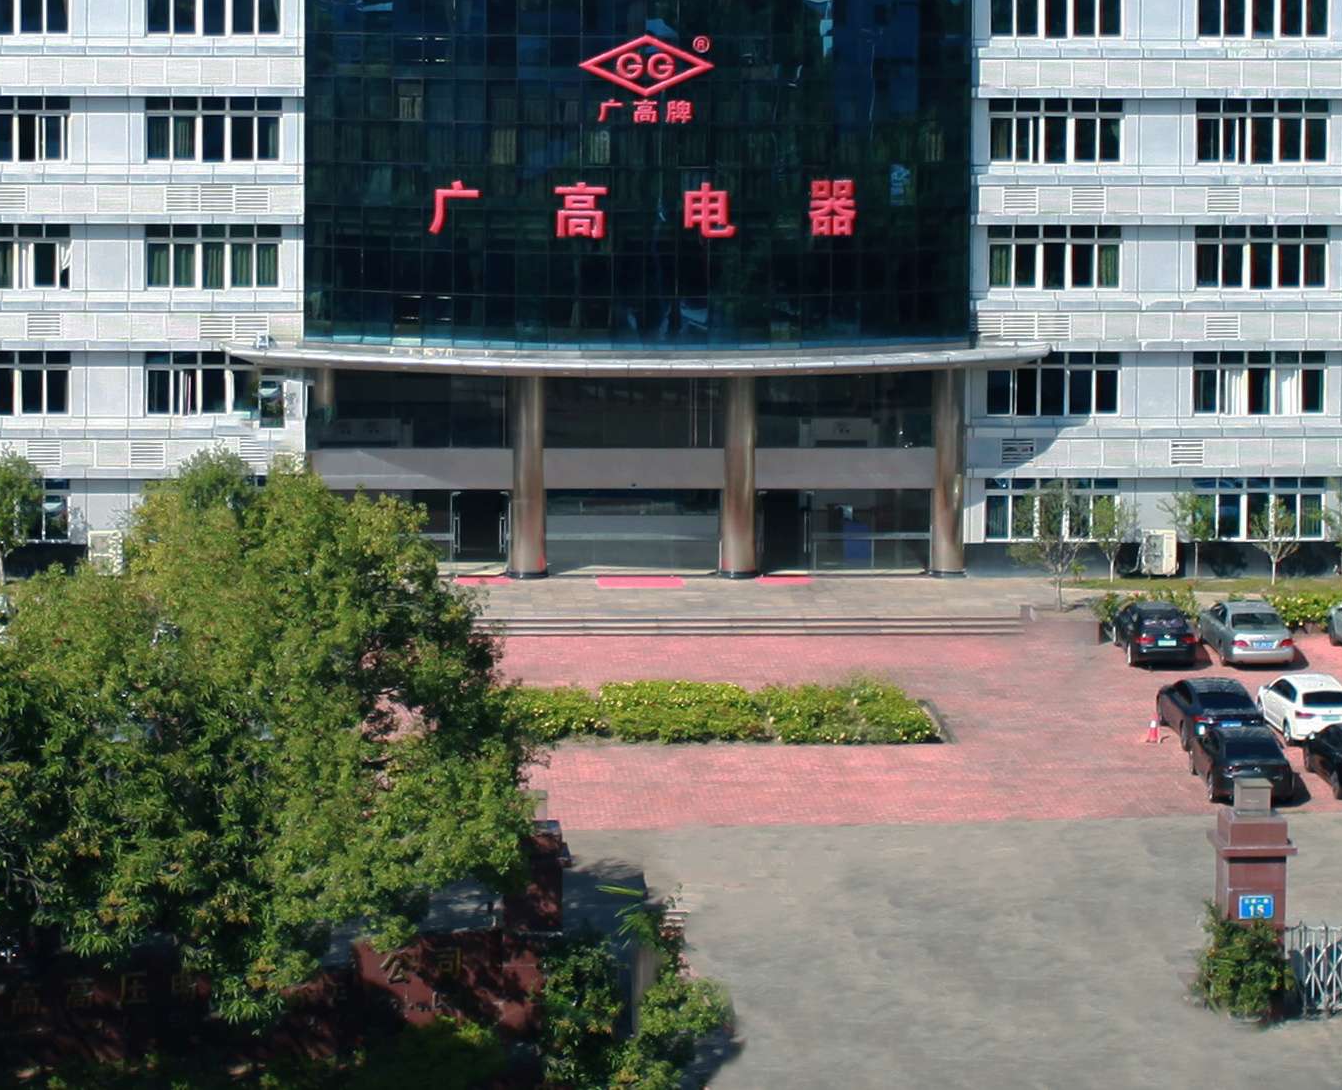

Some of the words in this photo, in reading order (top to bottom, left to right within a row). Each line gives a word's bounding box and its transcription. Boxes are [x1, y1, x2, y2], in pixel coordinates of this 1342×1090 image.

[616, 52, 676, 81] GG
[598, 98, 694, 123] 广高牌
[428, 179, 858, 239] 广高电器
